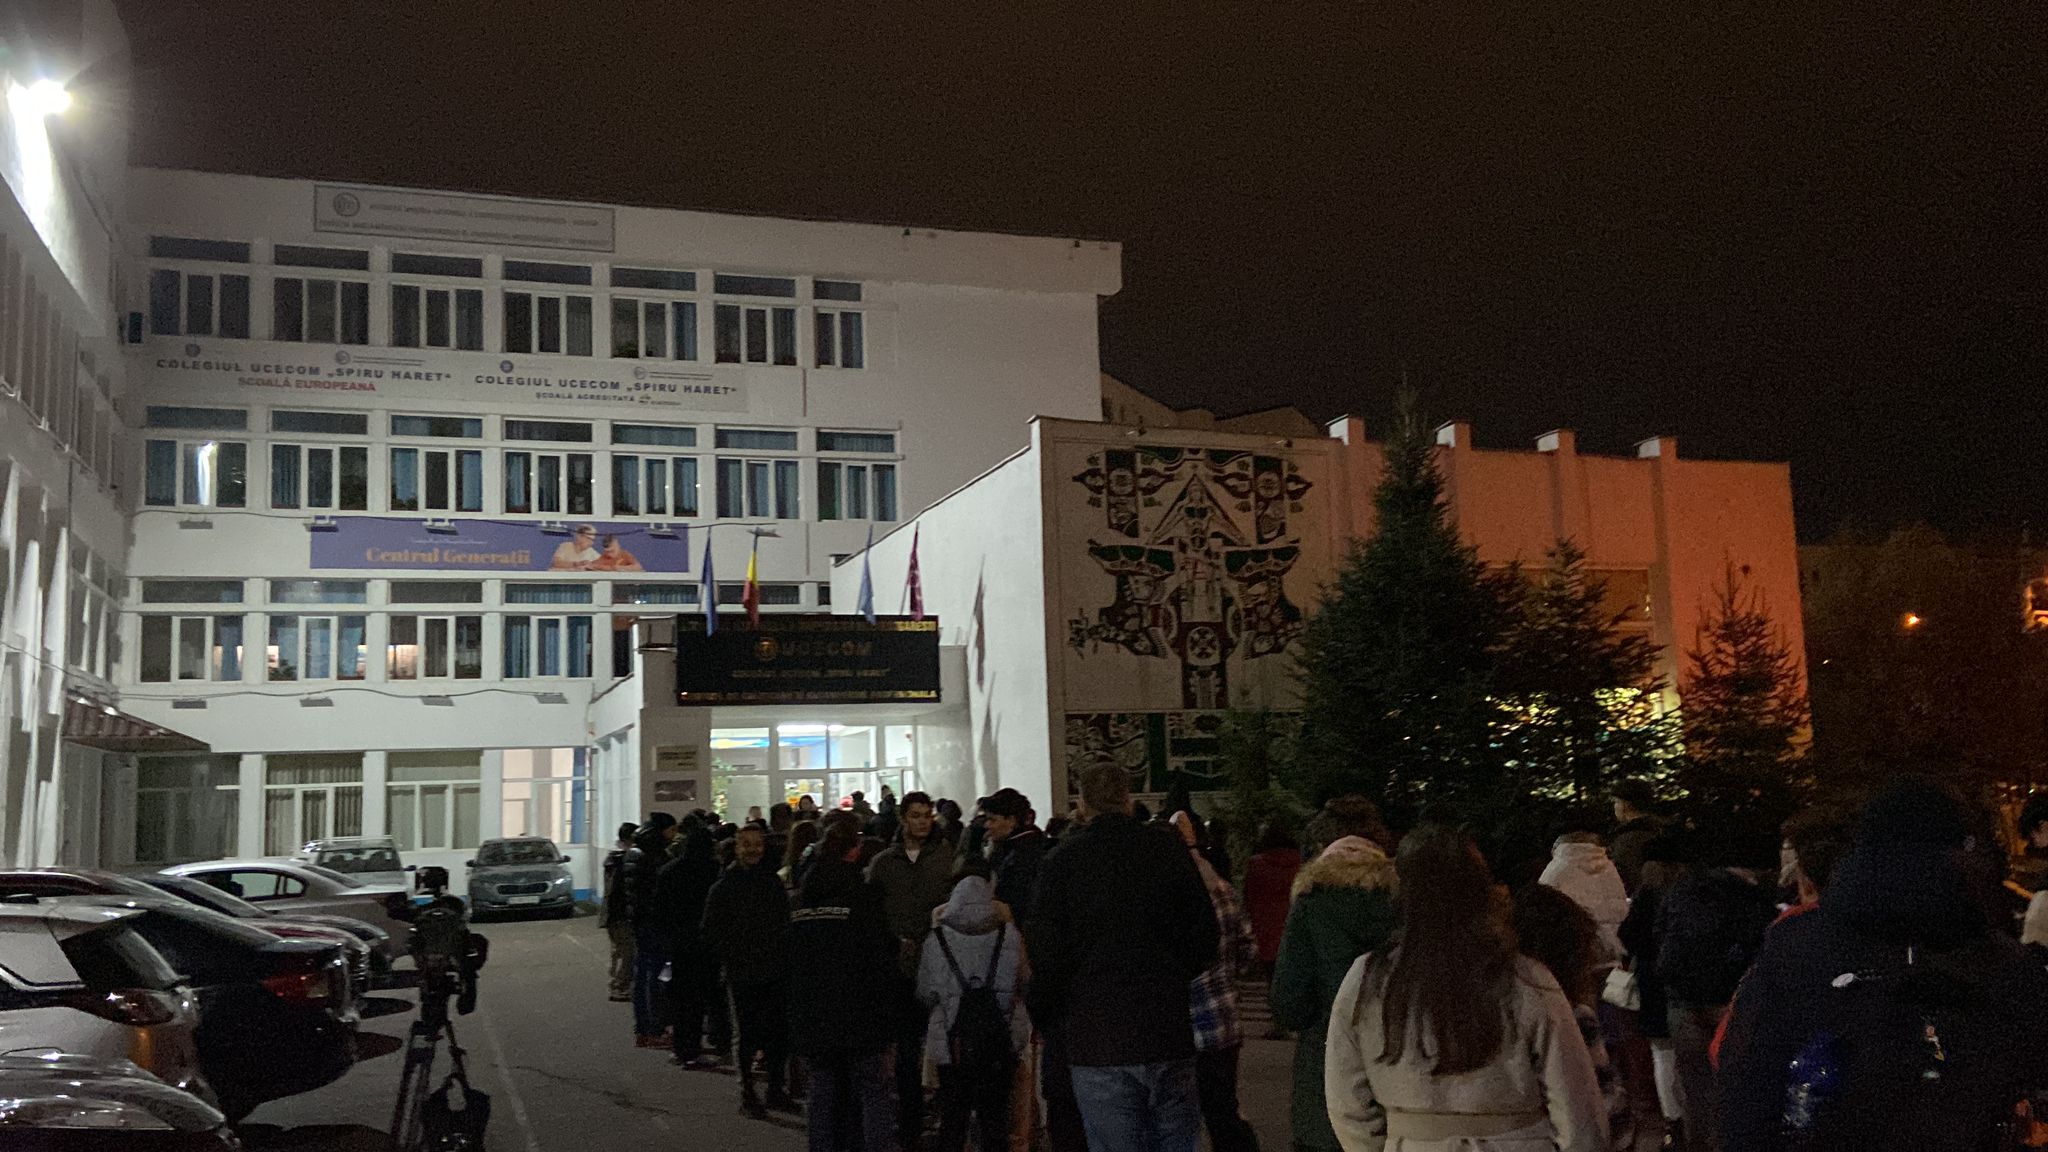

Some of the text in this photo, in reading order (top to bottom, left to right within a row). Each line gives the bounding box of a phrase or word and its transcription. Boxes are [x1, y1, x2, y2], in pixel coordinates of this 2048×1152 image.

[156, 358, 242, 372] COLEGIUL
[250, 363, 320, 376] UCECOM
[475, 374, 552, 387] COLEGIUL
[559, 379, 620, 390] UCECOM
[366, 547, 439, 564] Centrul
